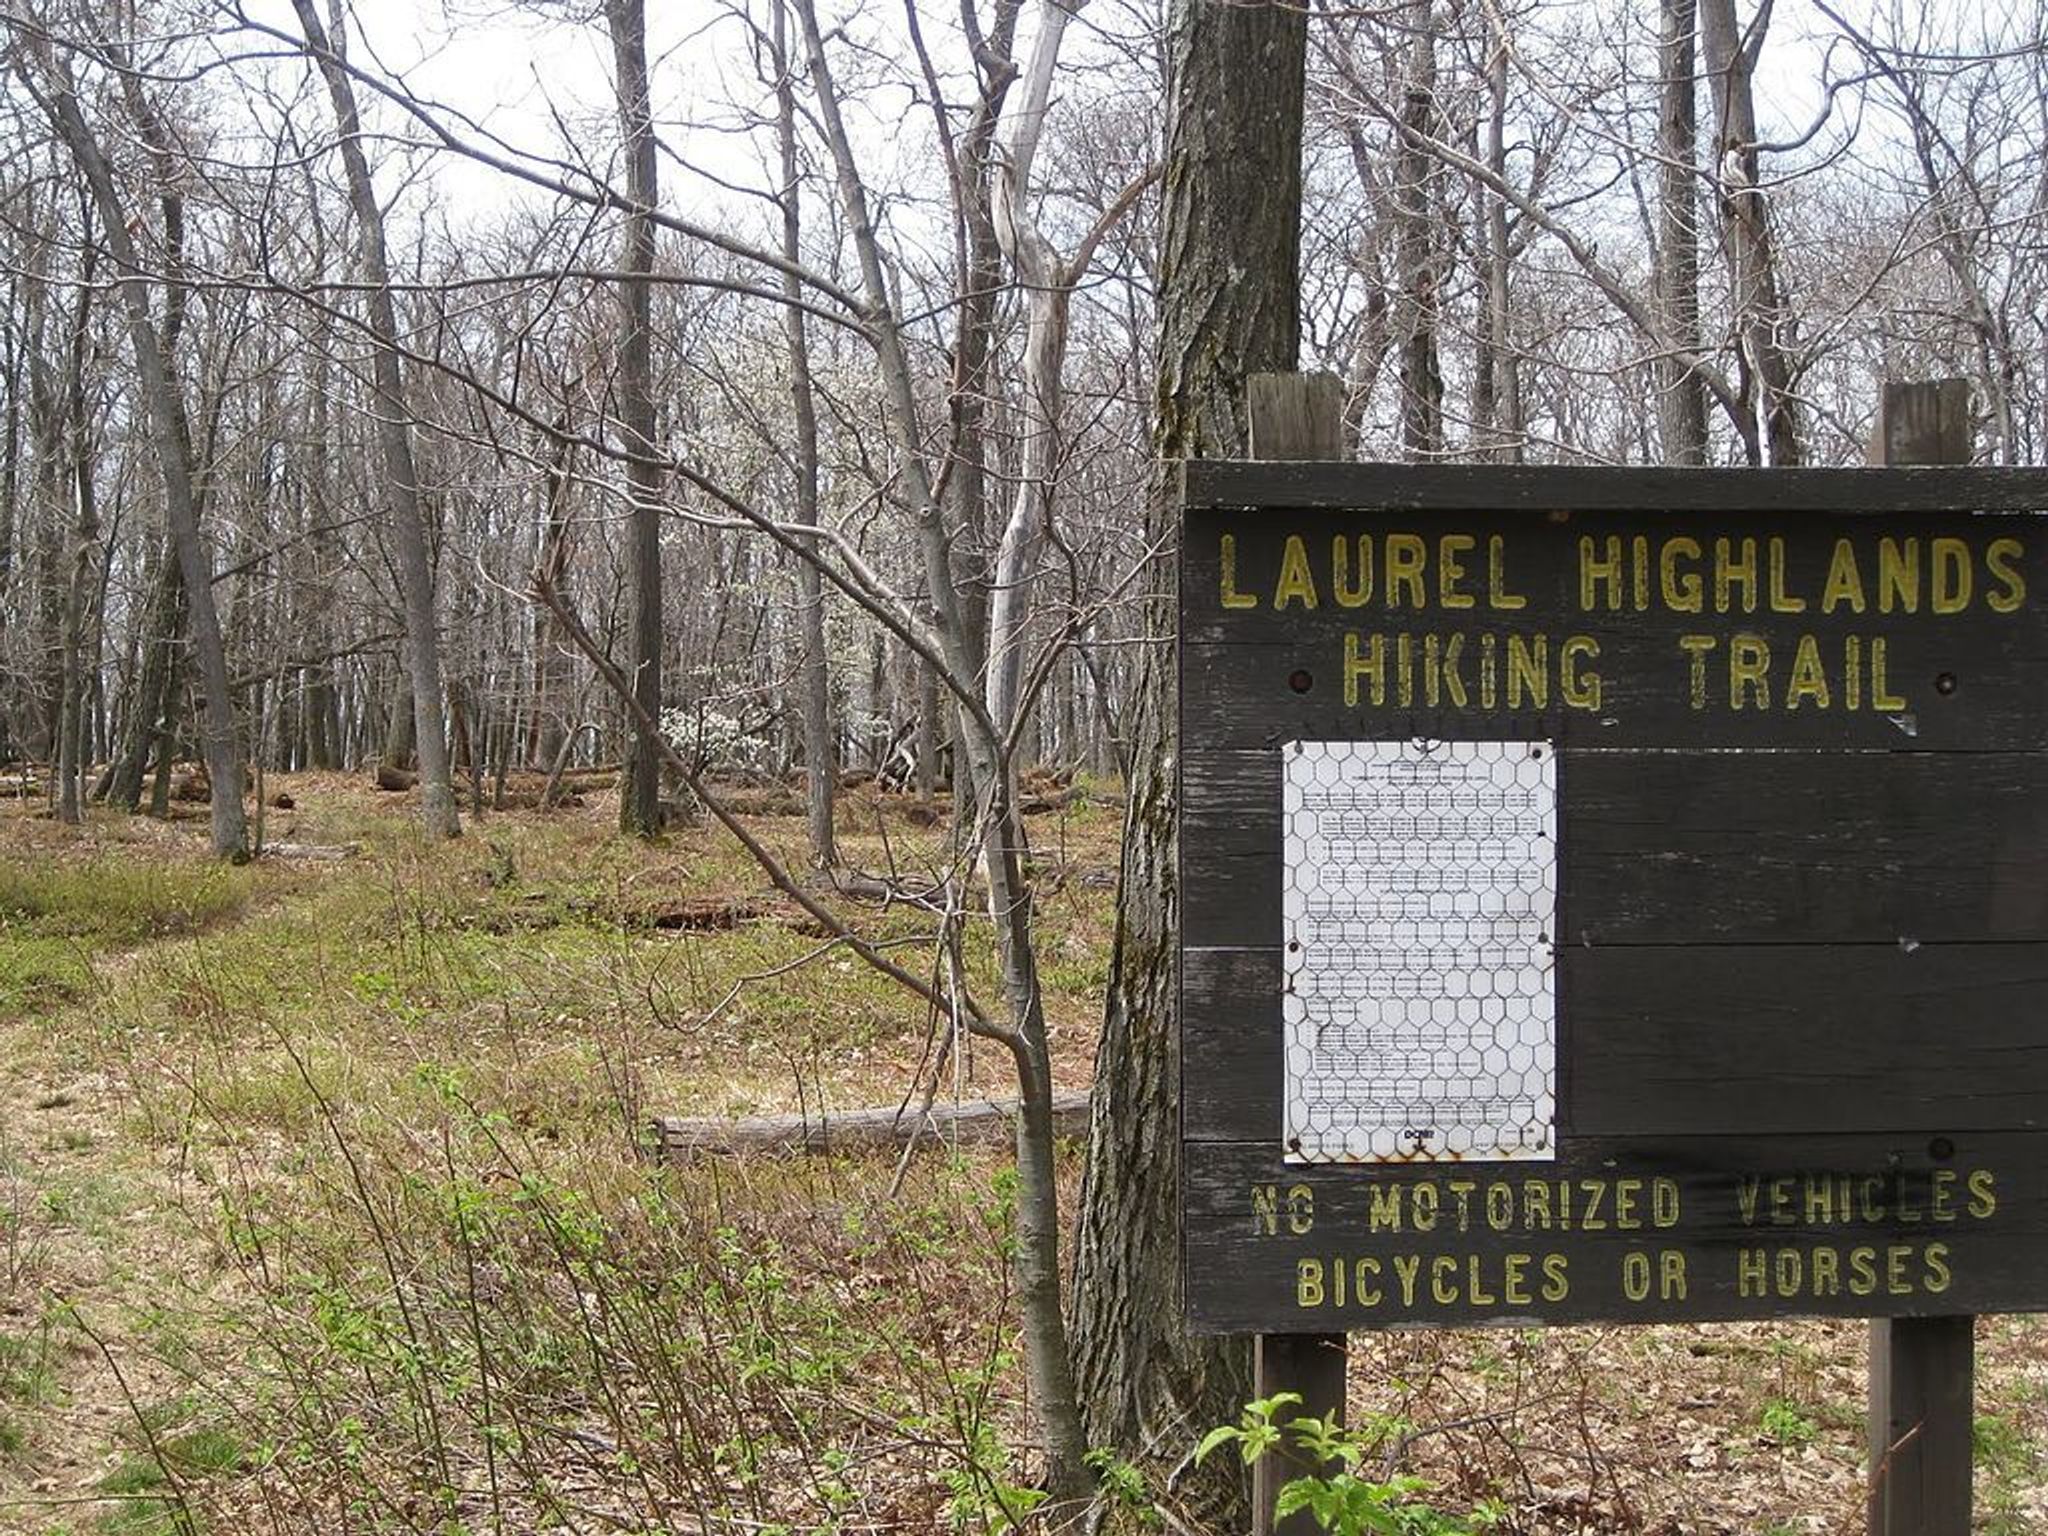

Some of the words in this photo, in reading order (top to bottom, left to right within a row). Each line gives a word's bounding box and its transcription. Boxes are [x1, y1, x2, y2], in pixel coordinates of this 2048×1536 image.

[1220, 534, 1529, 610] LAUREL
[1578, 536, 2026, 614] HIGHLANDS
[1343, 632, 1602, 710] HIKING
[1679, 633, 1907, 712] TRAIL
[1251, 1183, 1315, 1235] NO
[1368, 1177, 1681, 1233] MOTORIZED
[1736, 1169, 1997, 1226] VEHICLES
[1295, 1252, 1570, 1308] BICYCLES
[1623, 1248, 1688, 1302] OR
[1738, 1242, 1953, 1298] HORSES
